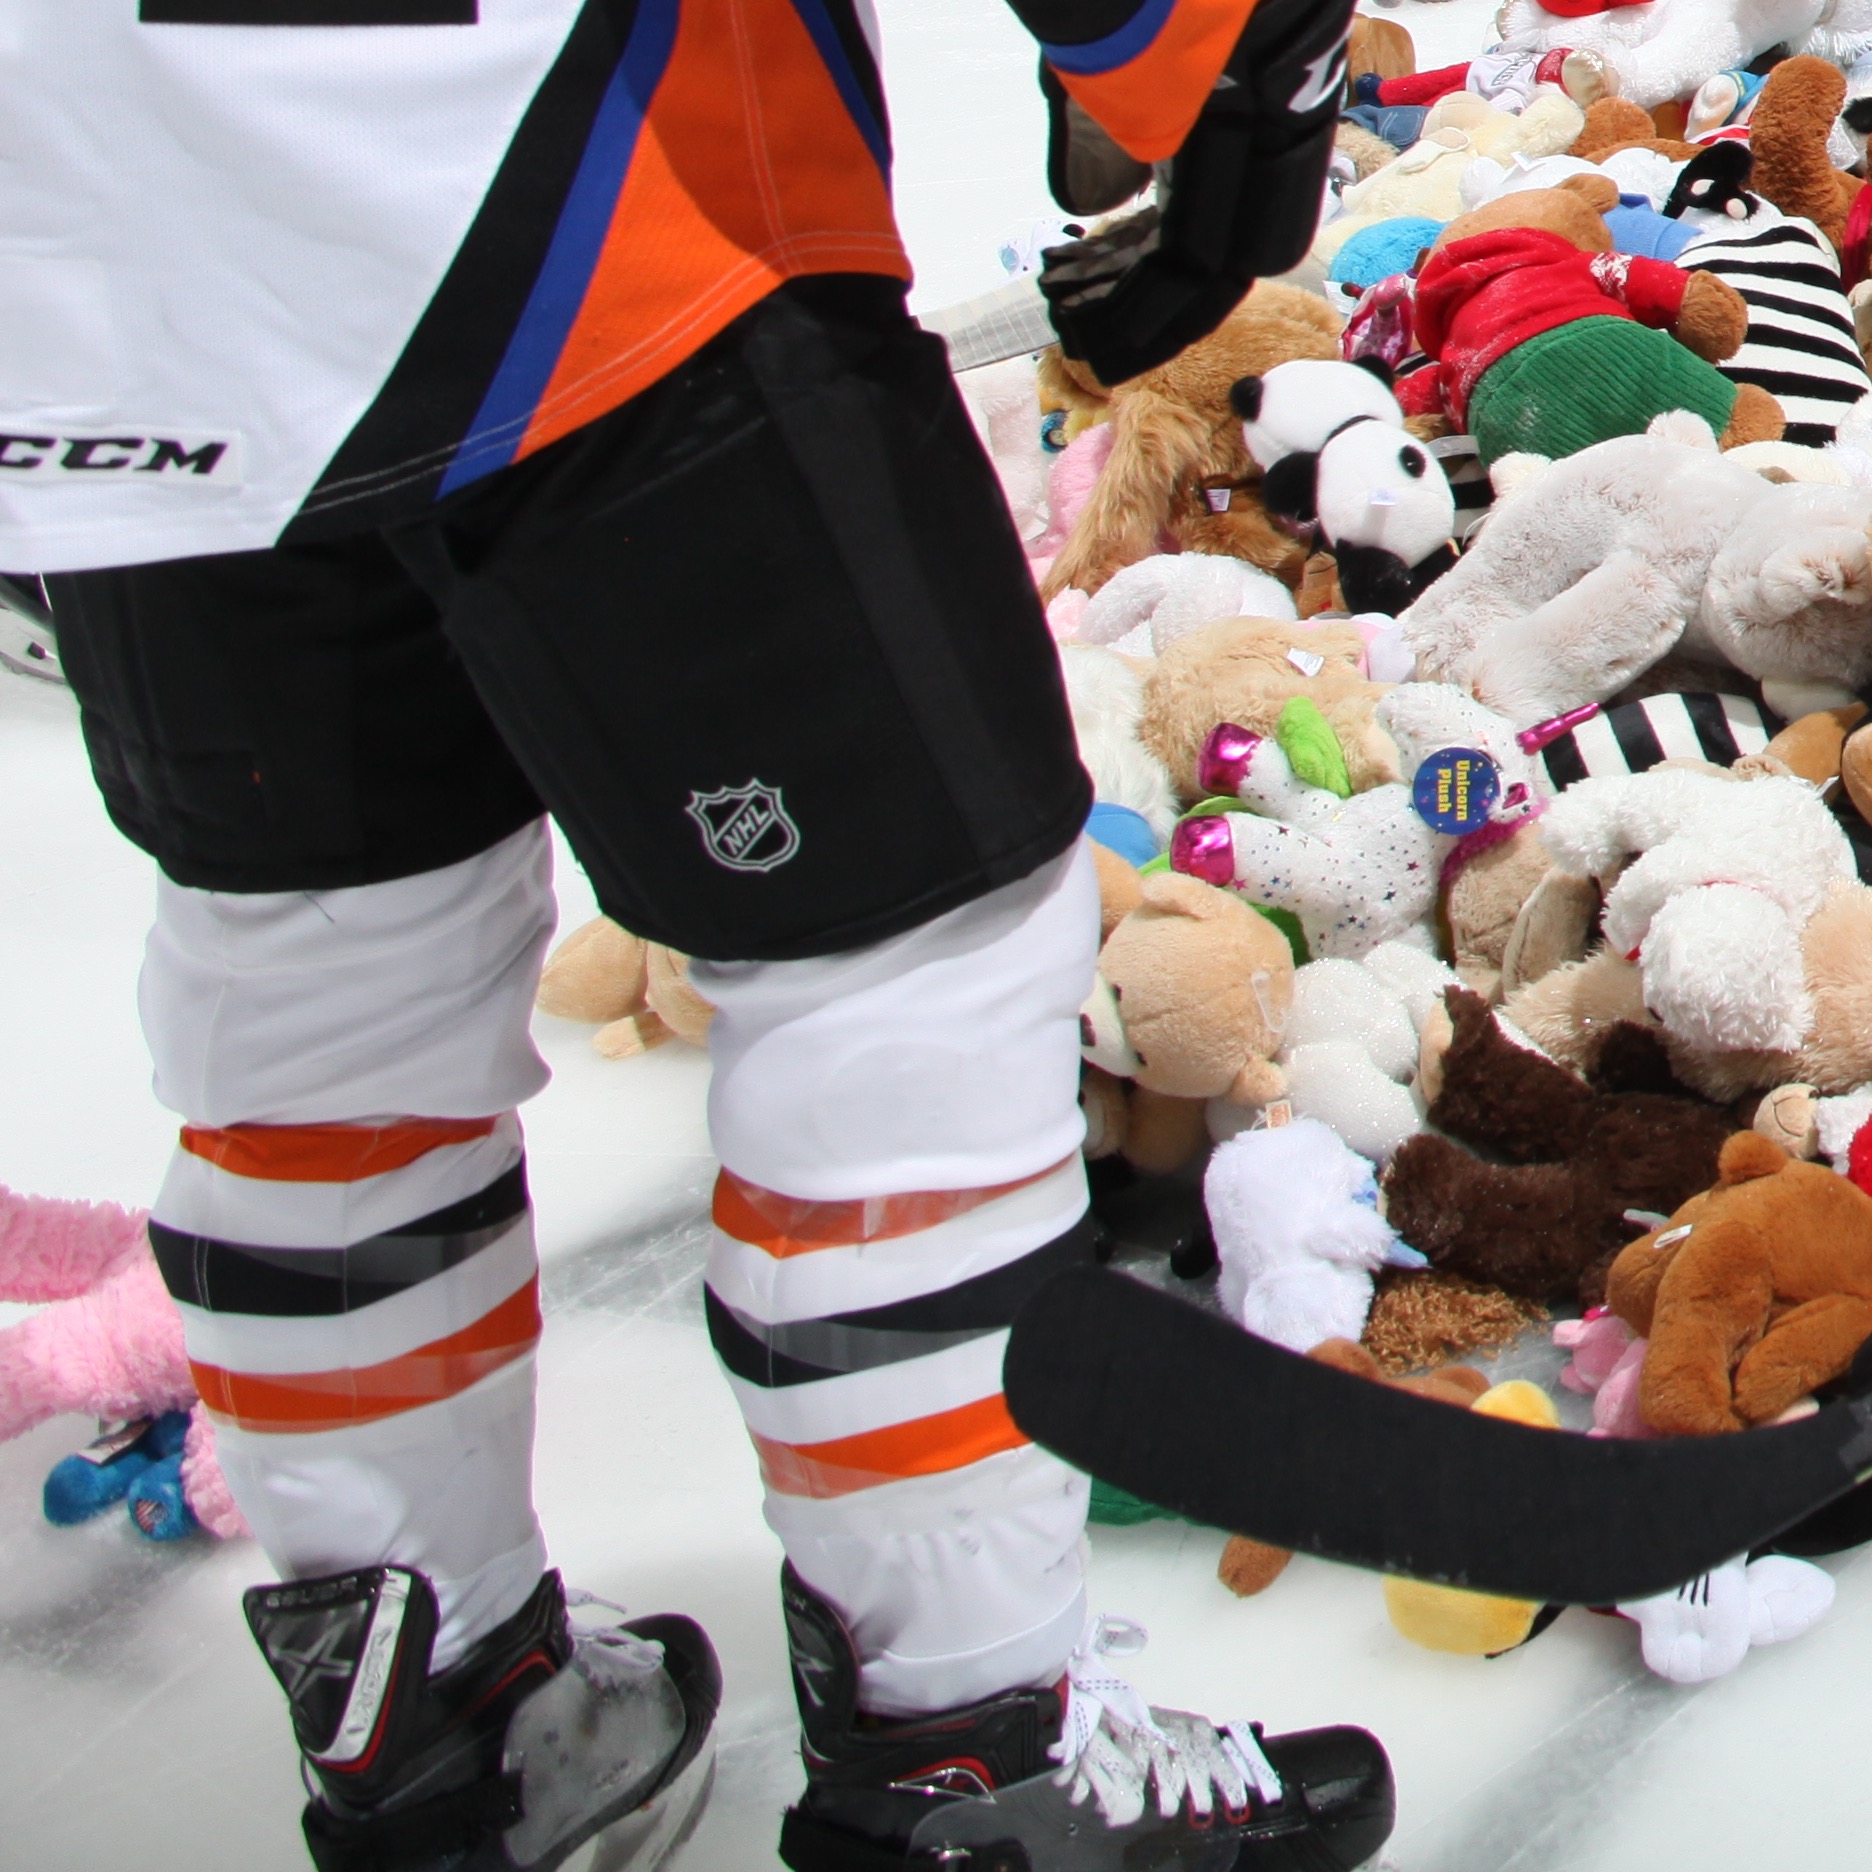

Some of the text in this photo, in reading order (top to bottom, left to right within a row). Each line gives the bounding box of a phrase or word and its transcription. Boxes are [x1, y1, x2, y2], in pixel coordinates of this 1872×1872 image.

[1437, 768, 1452, 813] Plush
[1455, 759, 1470, 821] Unicorn
[723, 803, 769, 855] NHL
